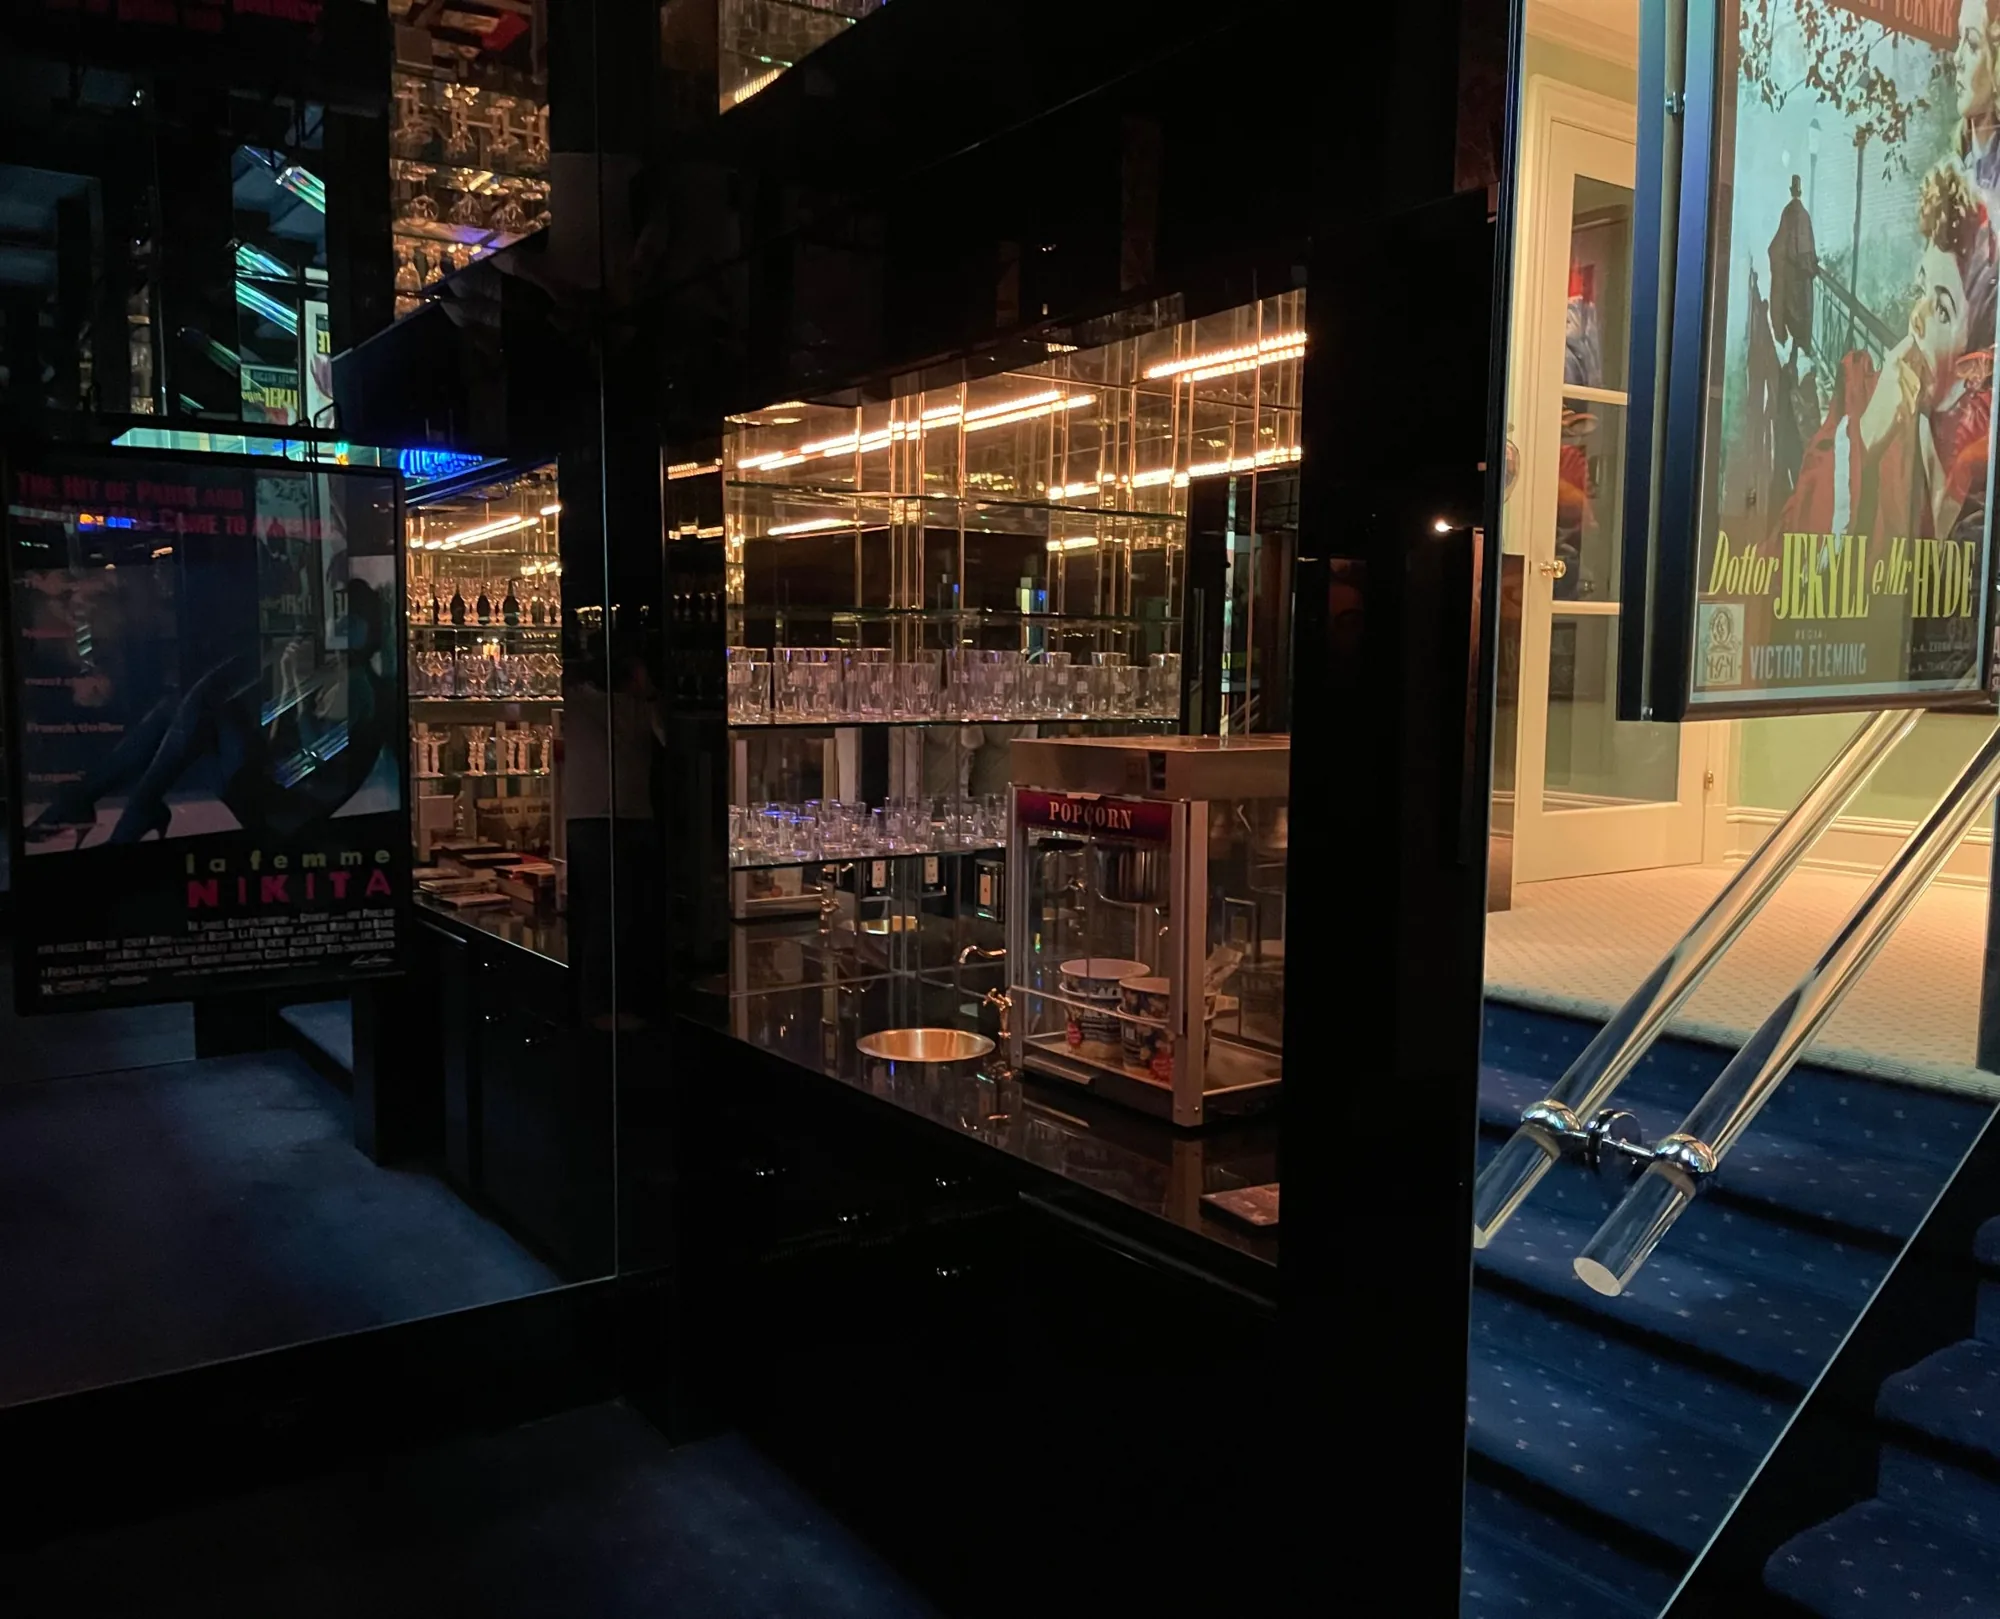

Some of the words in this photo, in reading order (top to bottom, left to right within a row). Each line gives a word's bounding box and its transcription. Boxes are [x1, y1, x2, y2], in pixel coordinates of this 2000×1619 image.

[1707, 530, 1779, 596] Dottor
[1773, 532, 1870, 620] JEKYLL
[1872, 559, 1885, 595] e
[1911, 538, 1976, 619] HYDE
[1750, 644, 1804, 681] VICTOR
[1808, 642, 1867, 679] FLEMING
[1049, 801, 1132, 830] POPCORN
[185, 851, 227, 875] la
[248, 848, 391, 872] femme
[186, 867, 393, 910] NIKITA
